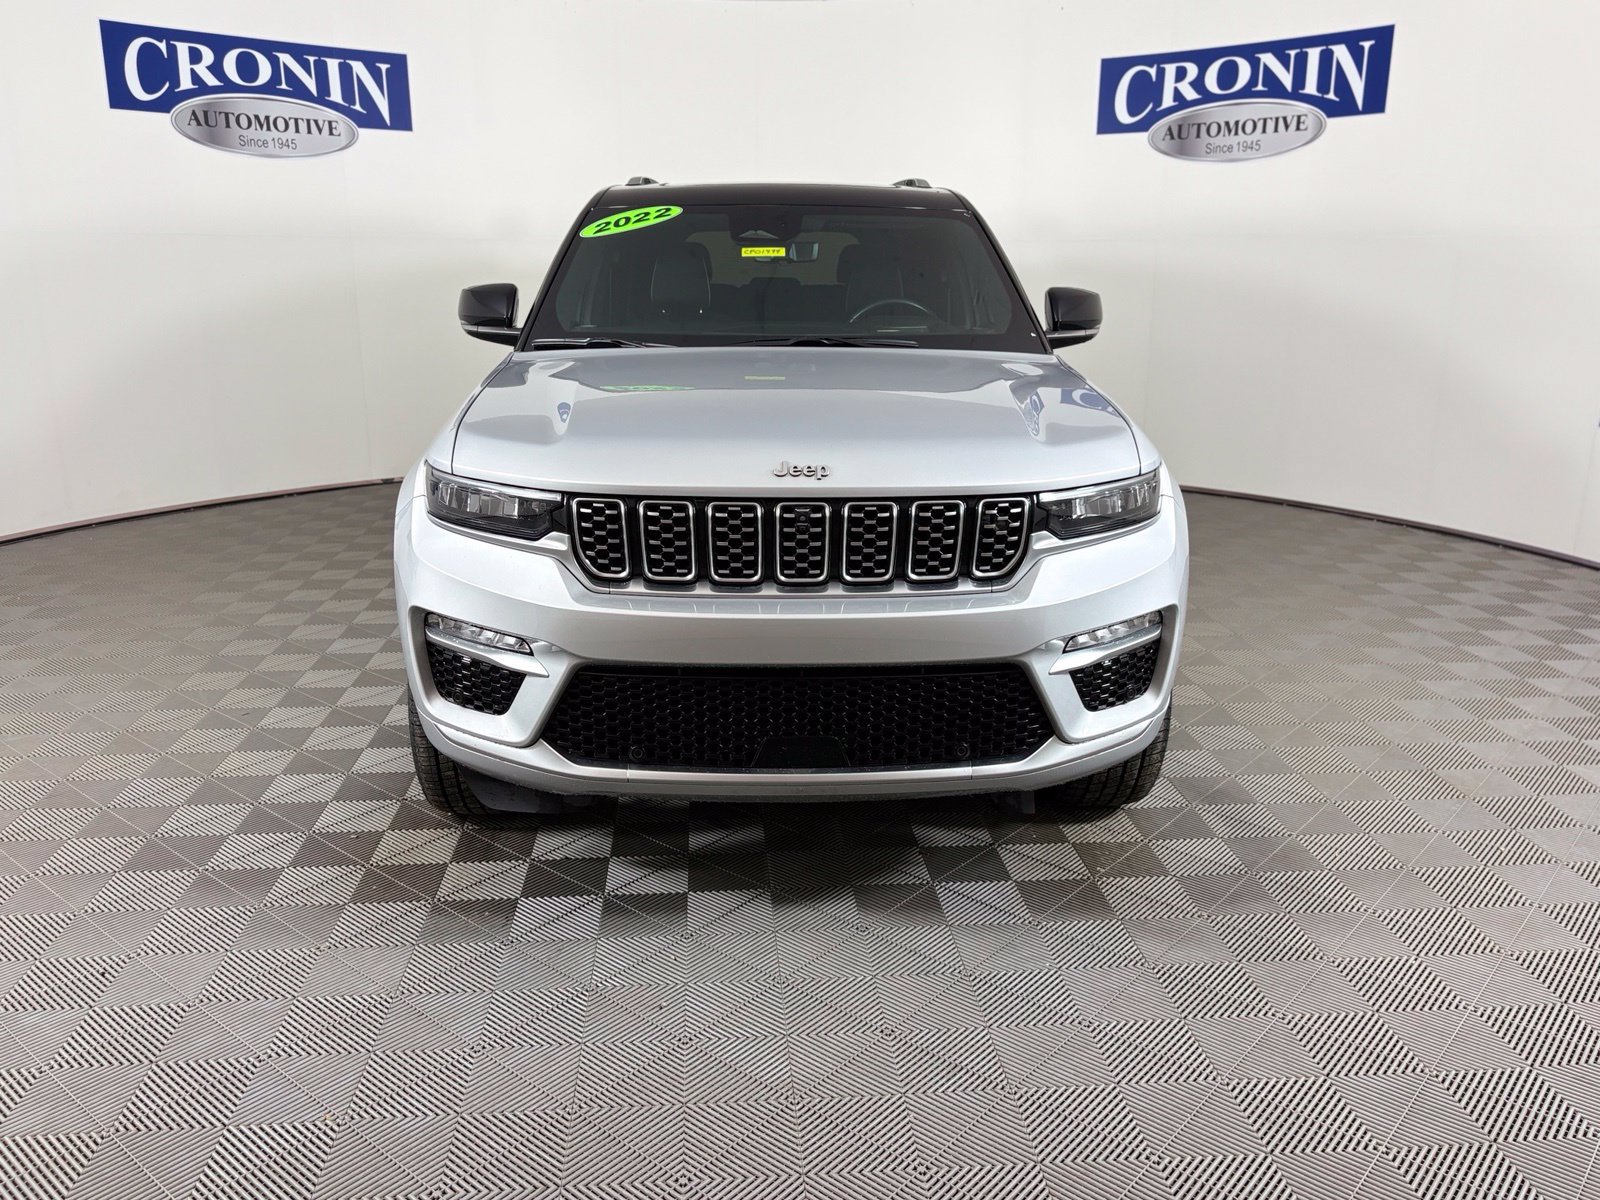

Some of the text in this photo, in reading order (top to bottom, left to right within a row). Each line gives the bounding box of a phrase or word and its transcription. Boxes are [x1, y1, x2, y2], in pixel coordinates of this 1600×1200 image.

[124, 36, 391, 127] CRONIN
[1114, 40, 1376, 125] CRONIN
[187, 109, 341, 137] AUTOMOTIVE
[1162, 114, 1309, 141] AUTOMOTIVE
[238, 134, 298, 150] Since 1945
[1204, 139, 1262, 155] Since 1945
[592, 207, 673, 235] 2022
[773, 460, 831, 480] Jeep
